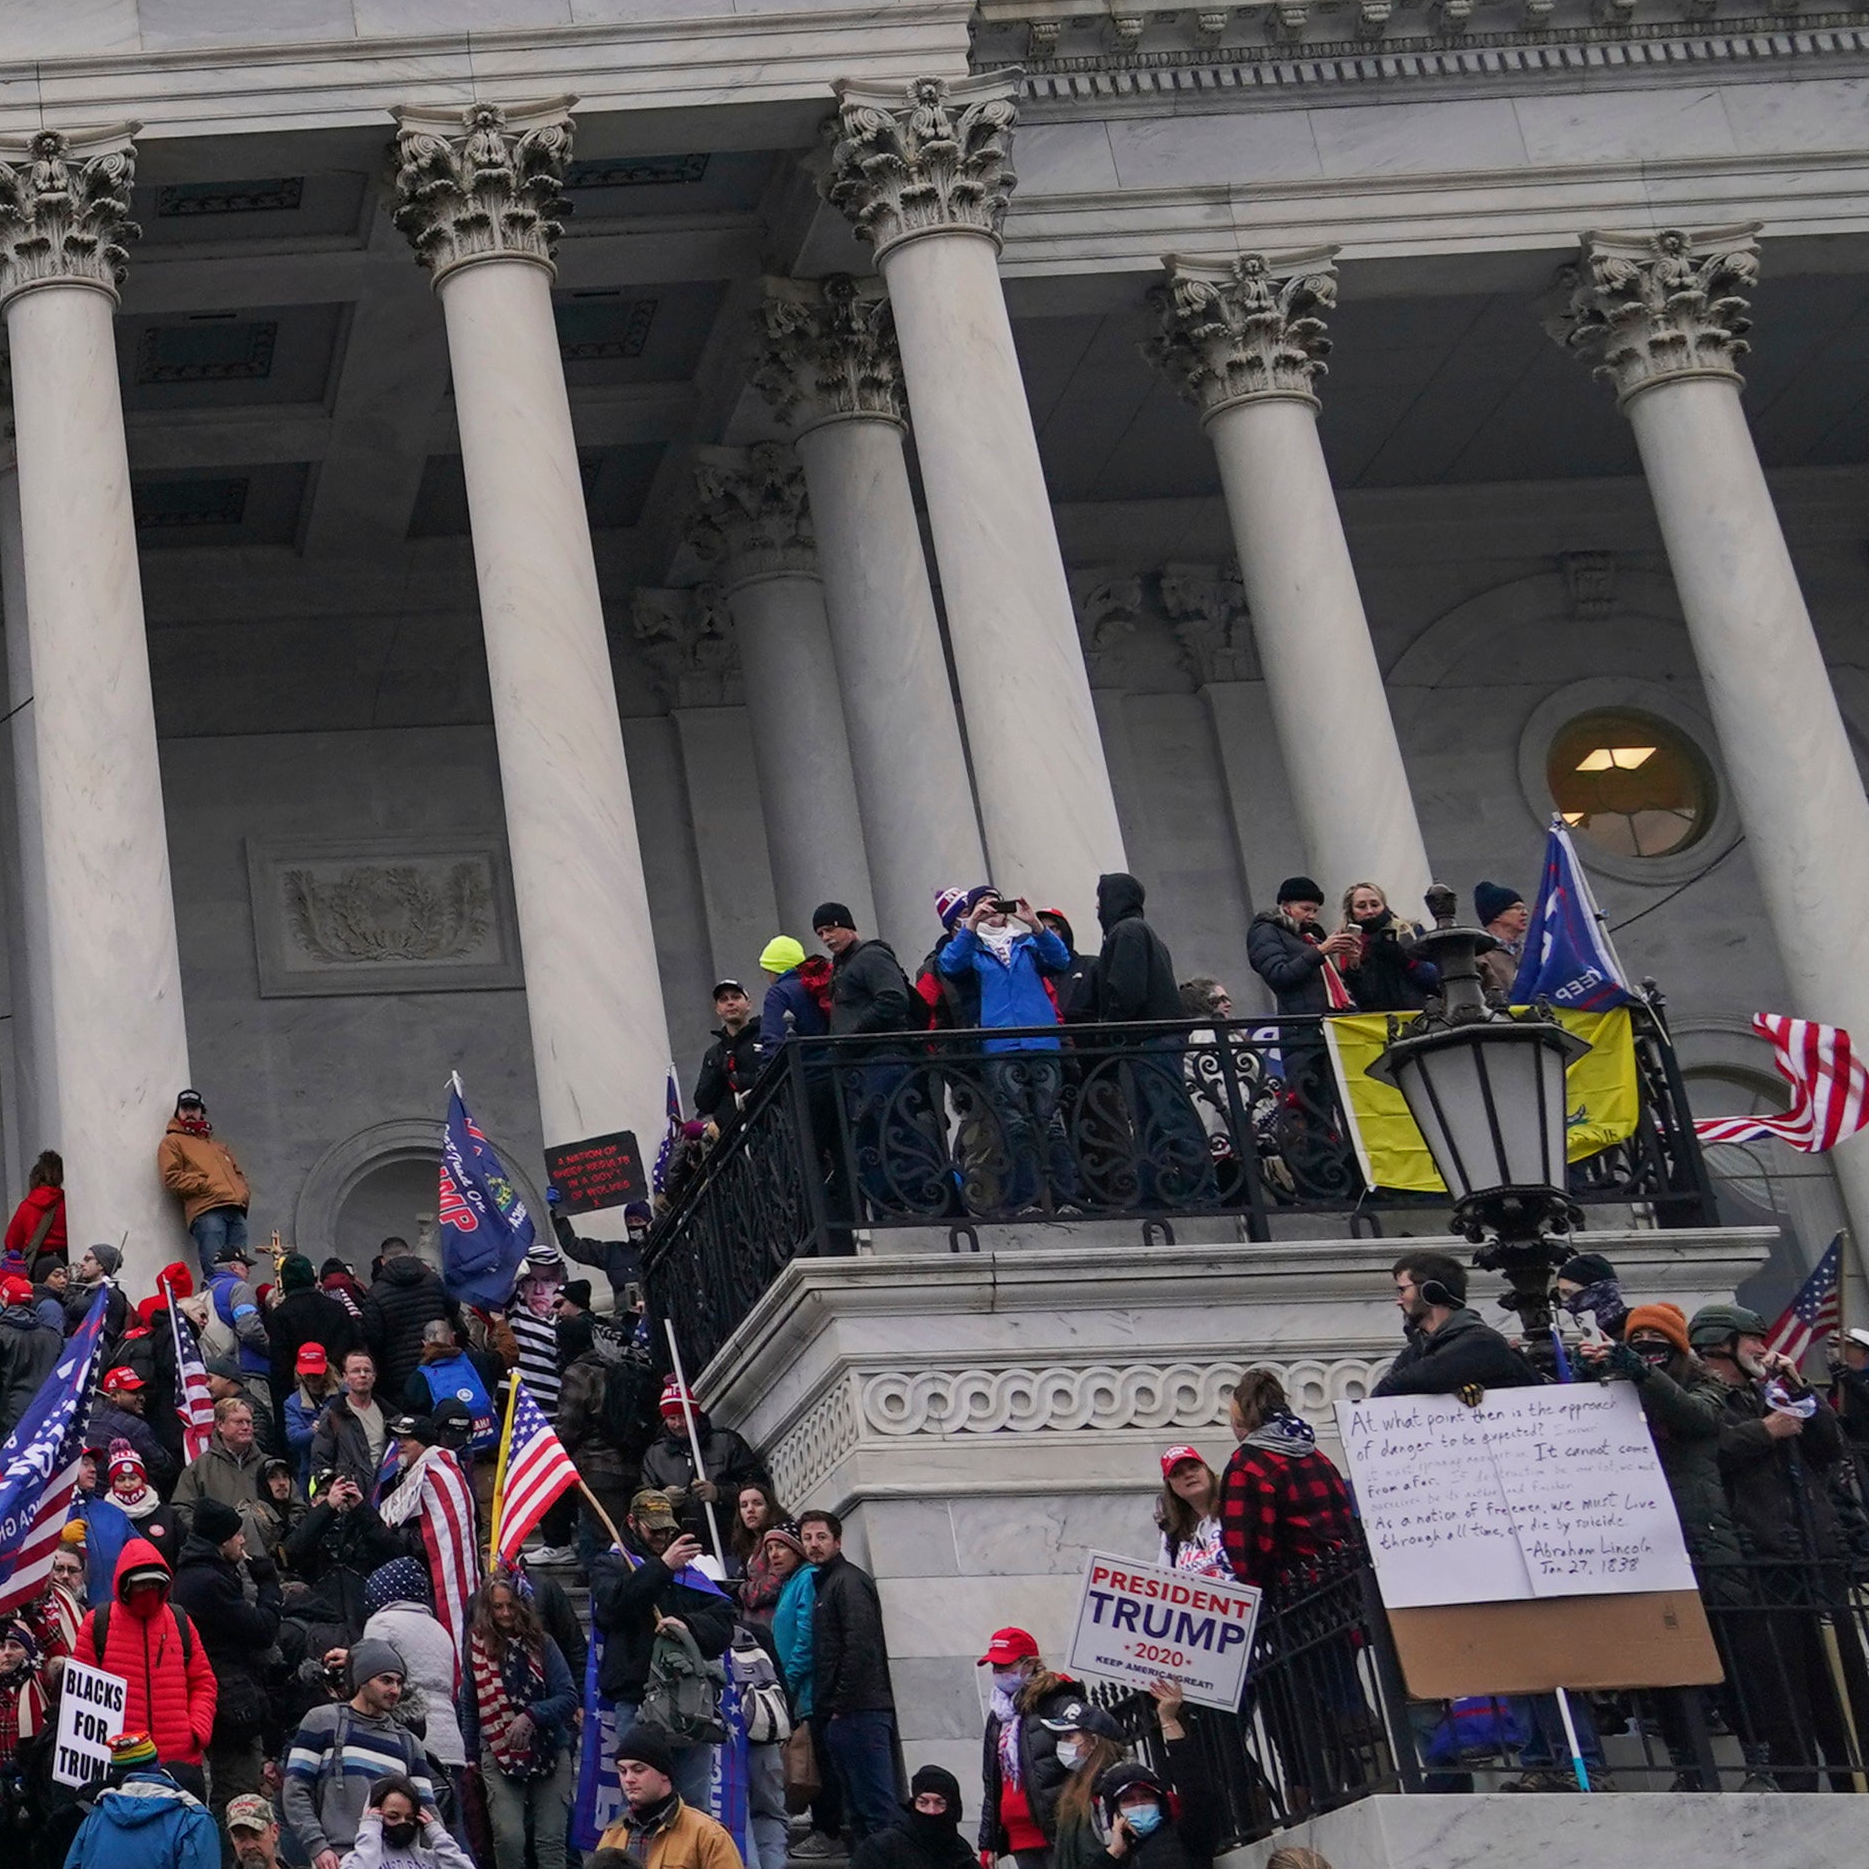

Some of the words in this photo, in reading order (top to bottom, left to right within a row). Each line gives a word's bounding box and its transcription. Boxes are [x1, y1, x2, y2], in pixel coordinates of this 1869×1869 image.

[1351, 1411, 1377, 1437] At
[1383, 1407, 1422, 1430] what
[1427, 1407, 1464, 1435] point
[1472, 1408, 1505, 1424] then
[1528, 1401, 1554, 1417] the
[1558, 1394, 1618, 1421] approach
[1357, 1440, 1374, 1462] of
[1381, 1439, 1433, 1461] danger
[1441, 1434, 1458, 1448] to
[1462, 1433, 1476, 1446] be
[1482, 1422, 1544, 1445] expected?
[1534, 1442, 1558, 1462] It
[1565, 1438, 1611, 1456] cannot
[1618, 1445, 1650, 1455] come
[1375, 1516, 1393, 1530] As
[1401, 1517, 1411, 1527] a
[1416, 1509, 1457, 1524] nation
[1465, 1501, 1478, 1519] of
[1551, 1501, 1574, 1511] we
[1582, 1492, 1618, 1511] must
[1379, 1528, 1442, 1550] through
[1447, 1523, 1466, 1541] all
[1470, 1521, 1504, 1538] time,
[1508, 1523, 1524, 1534] or
[1530, 1518, 1550, 1531] die
[1557, 1517, 1570, 1537] by
[1600, 1535, 1655, 1556] Lincoln
[1602, 1557, 1640, 1574] 1838
[1091, 1566, 1252, 1619] PRESIDENT
[1089, 1590, 1246, 1655] TRUMP
[1134, 1642, 1183, 1667] 2020
[65, 1669, 123, 1713] BLACKS
[1095, 1655, 1123, 1668] KEEP
[1125, 1662, 1175, 1682] AMERICA
[1173, 1673, 1214, 1692] GREAT!
[73, 1710, 109, 1745] FOR
